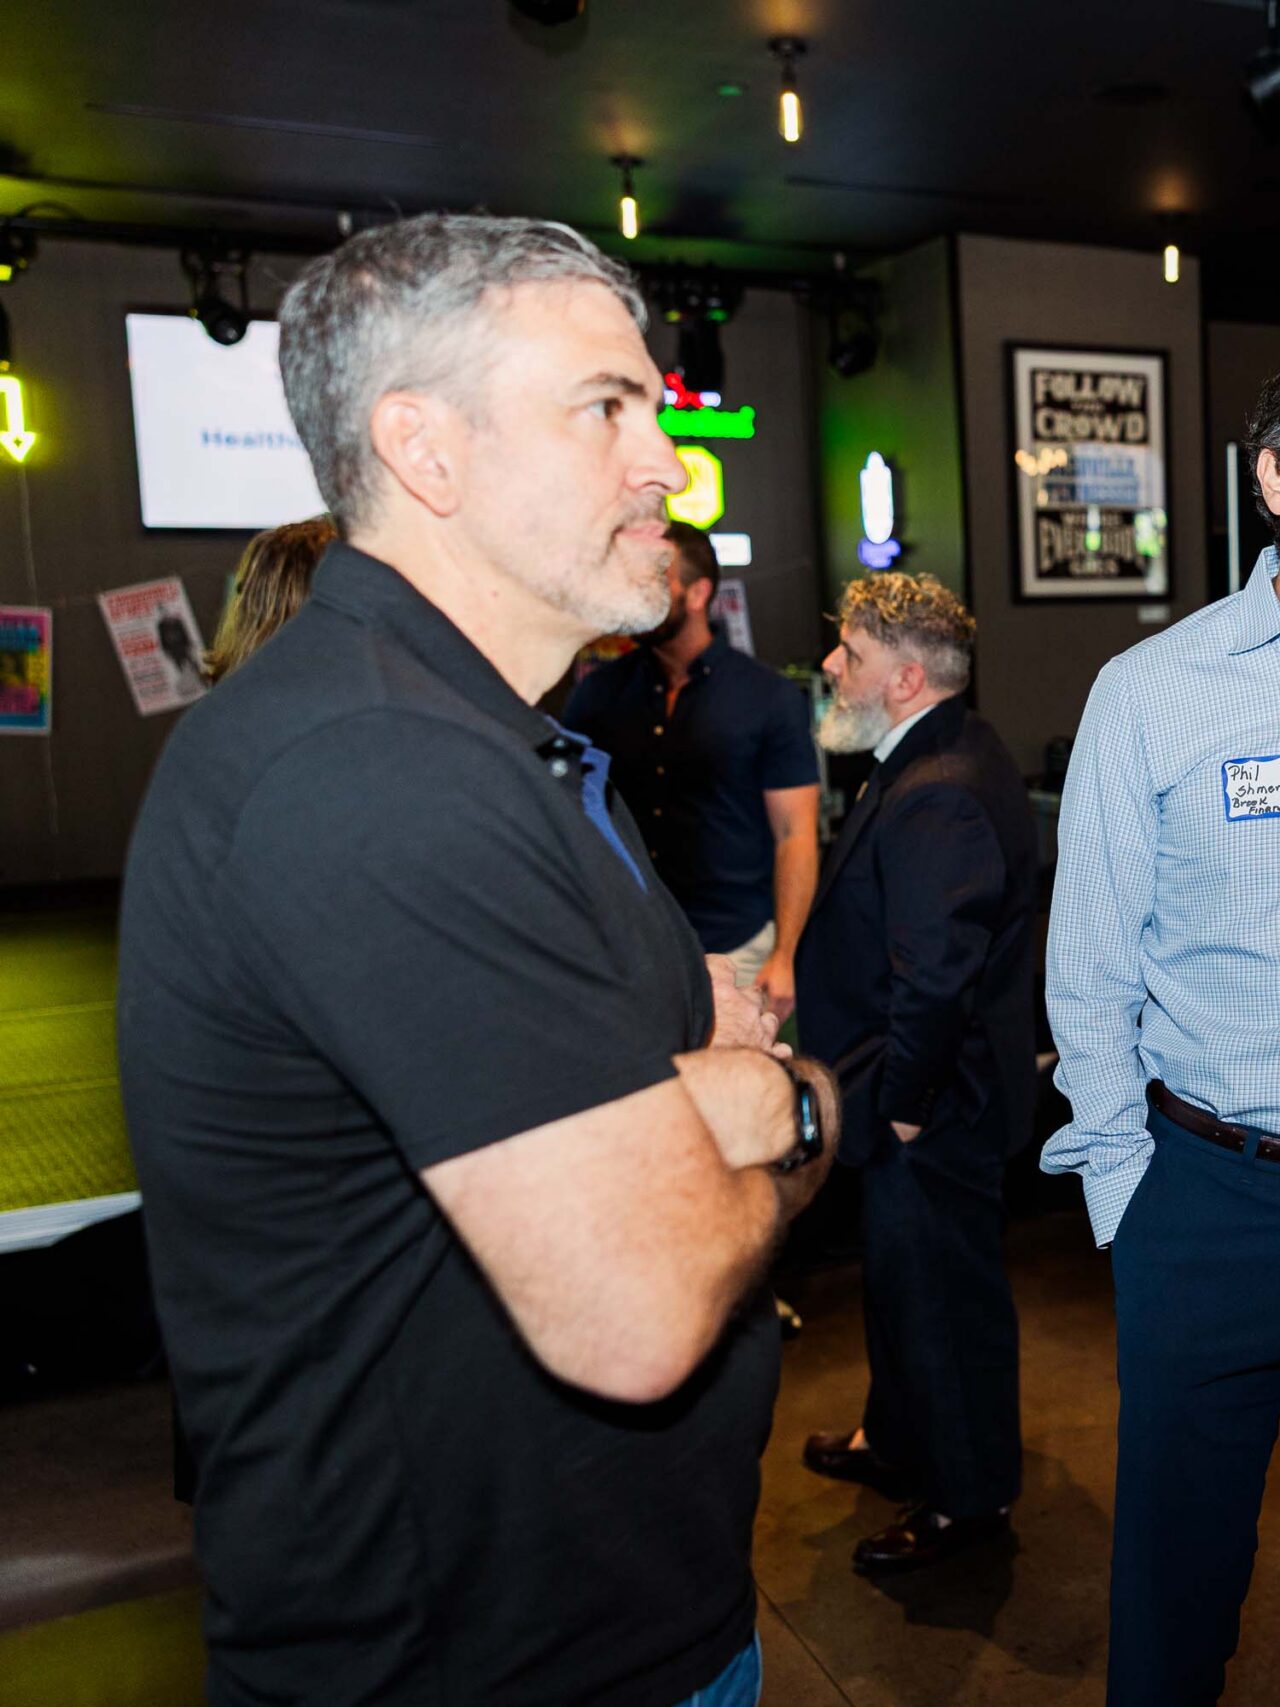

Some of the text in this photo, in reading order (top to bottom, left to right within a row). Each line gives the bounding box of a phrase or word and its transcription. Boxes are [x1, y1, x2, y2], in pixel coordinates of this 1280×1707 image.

[1035, 372, 1144, 407] FOLLOW
[1035, 408, 1145, 441] CROWD
[1228, 764, 1259, 781] Phil
